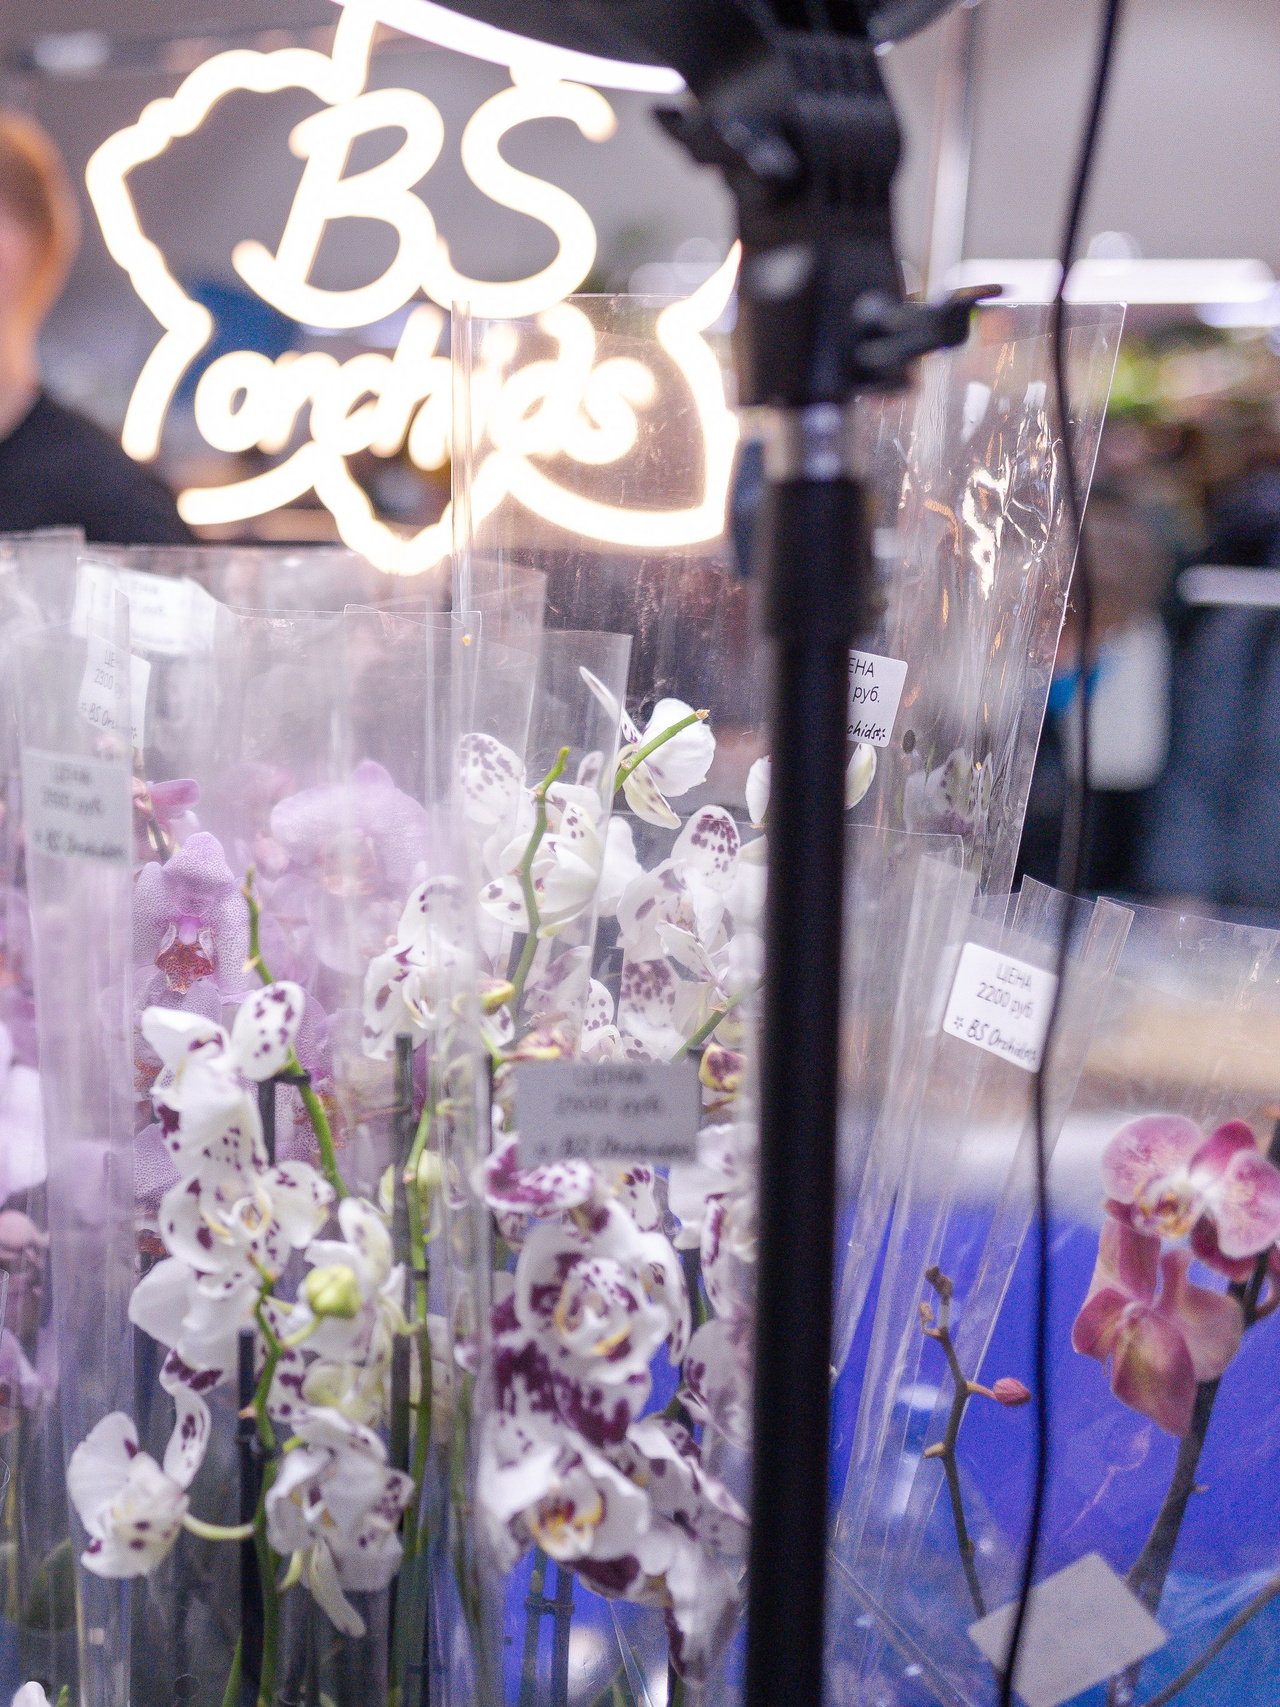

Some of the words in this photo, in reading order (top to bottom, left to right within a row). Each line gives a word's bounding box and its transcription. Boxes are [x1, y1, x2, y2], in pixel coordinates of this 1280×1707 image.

[232, 81, 616, 328] BS
[848, 657, 874, 677] ЕНА
[852, 686, 880, 704] руб.
[847, 720, 879, 740] chids
[977, 981, 1010, 1008] 2200
[966, 1019, 989, 1041] BS
